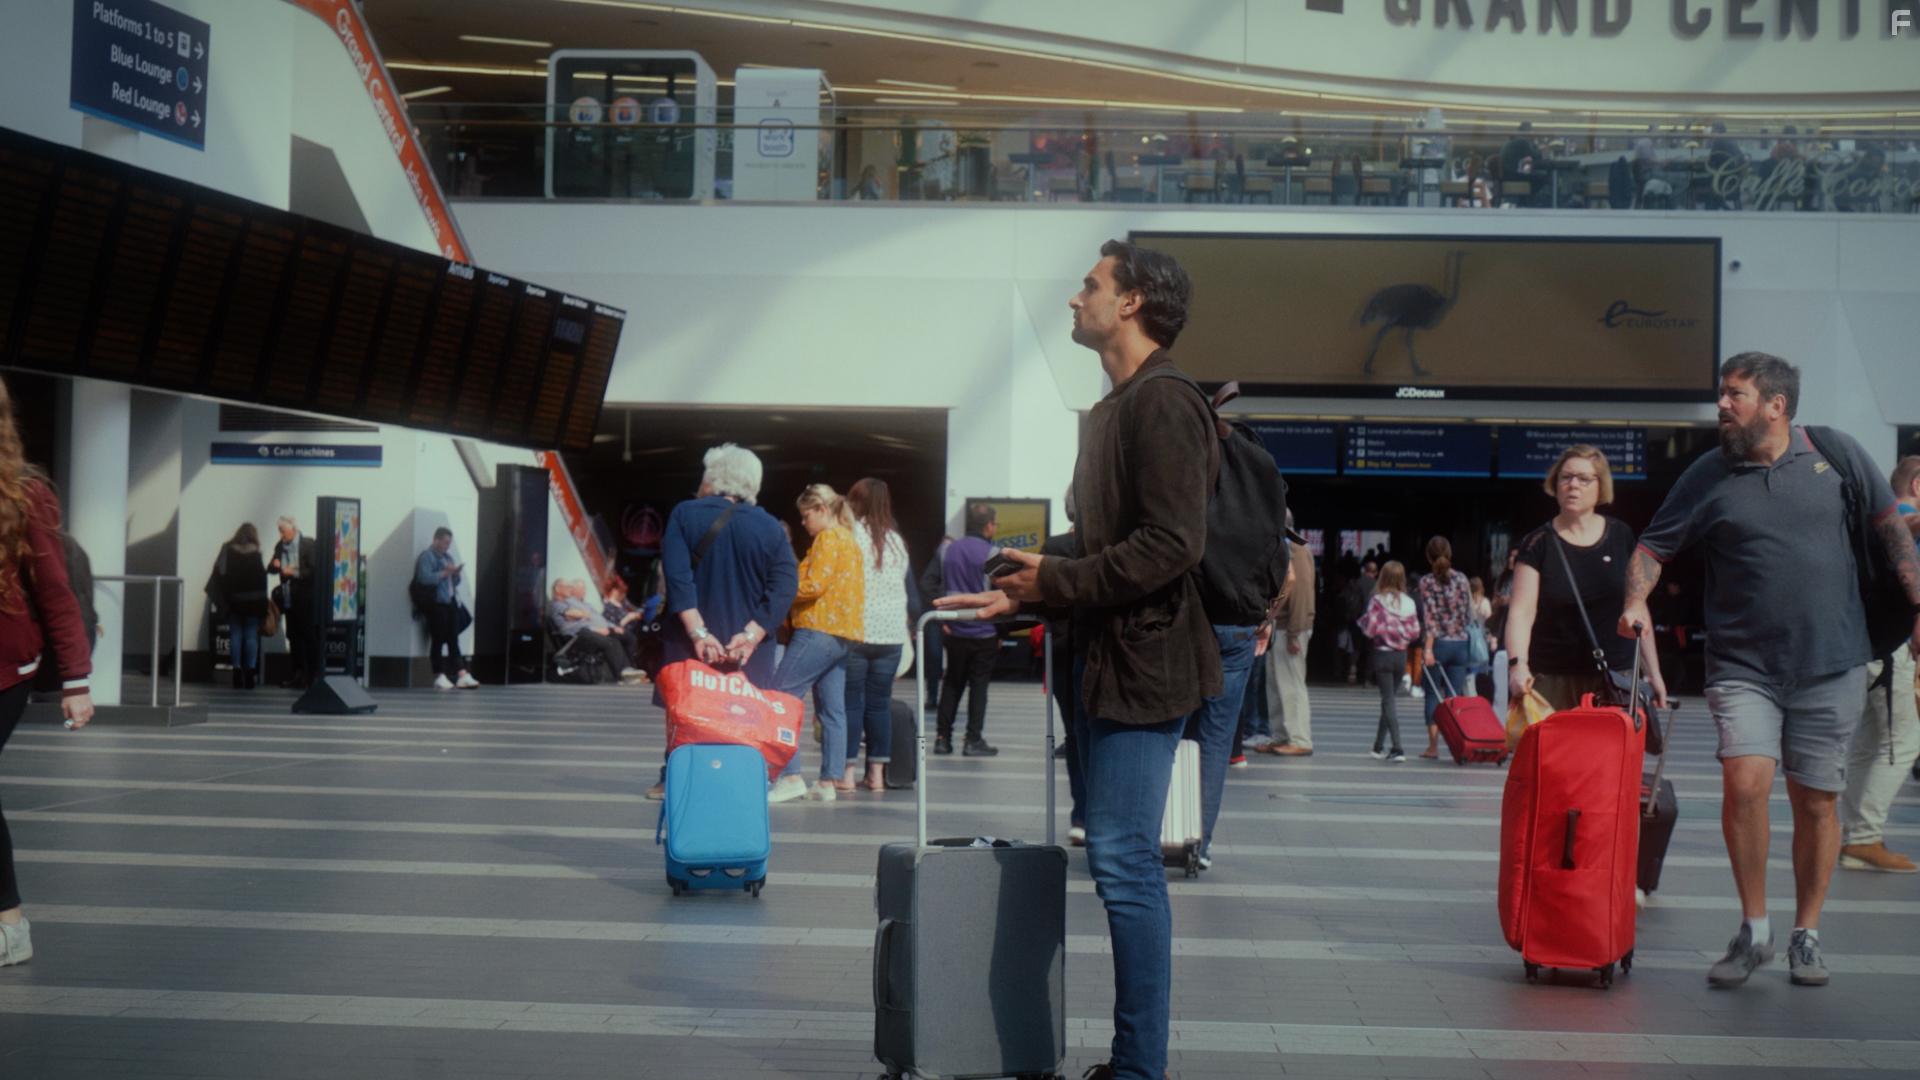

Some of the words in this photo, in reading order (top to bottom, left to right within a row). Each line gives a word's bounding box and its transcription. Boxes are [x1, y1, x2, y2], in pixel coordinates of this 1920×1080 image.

[93, 1, 143, 37] Platforms
[145, 22, 153, 41] 1
[153, 27, 165, 45] to
[167, 32, 174, 49] 5
[336, 8, 373, 81] Grand
[111, 43, 134, 69] Blue
[135, 52, 173, 85] Lounge
[112, 81, 132, 105] Red
[133, 89, 171, 120] Lounge
[1395, 387, 1445, 398] JCDecaux
[273, 446, 294, 457] Cash
[295, 446, 336, 458] machines
